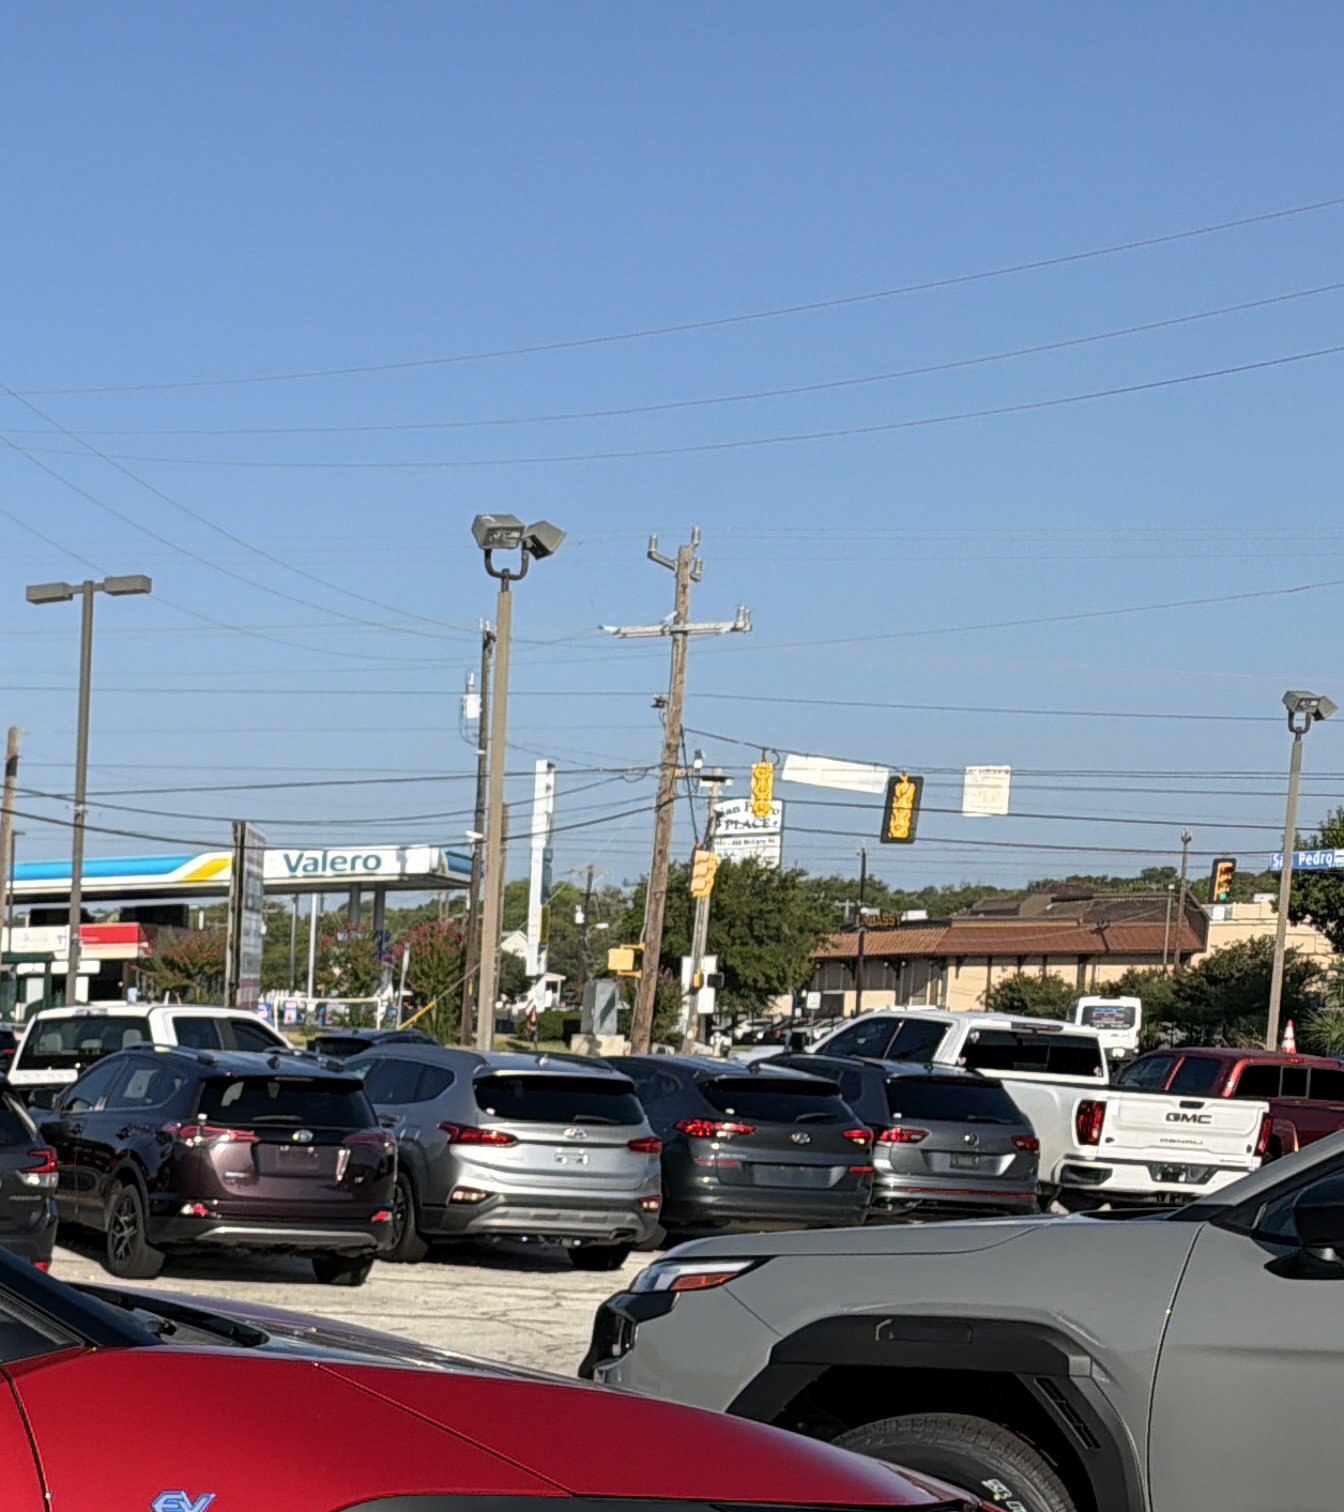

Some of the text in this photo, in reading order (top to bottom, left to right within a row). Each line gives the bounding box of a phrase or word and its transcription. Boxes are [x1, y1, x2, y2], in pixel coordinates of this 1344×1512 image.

[724, 819, 770, 830] PLACE
[284, 851, 382, 873] Valero
[1299, 850, 1333, 867] Pedro
[1165, 1112, 1212, 1124] GMC
